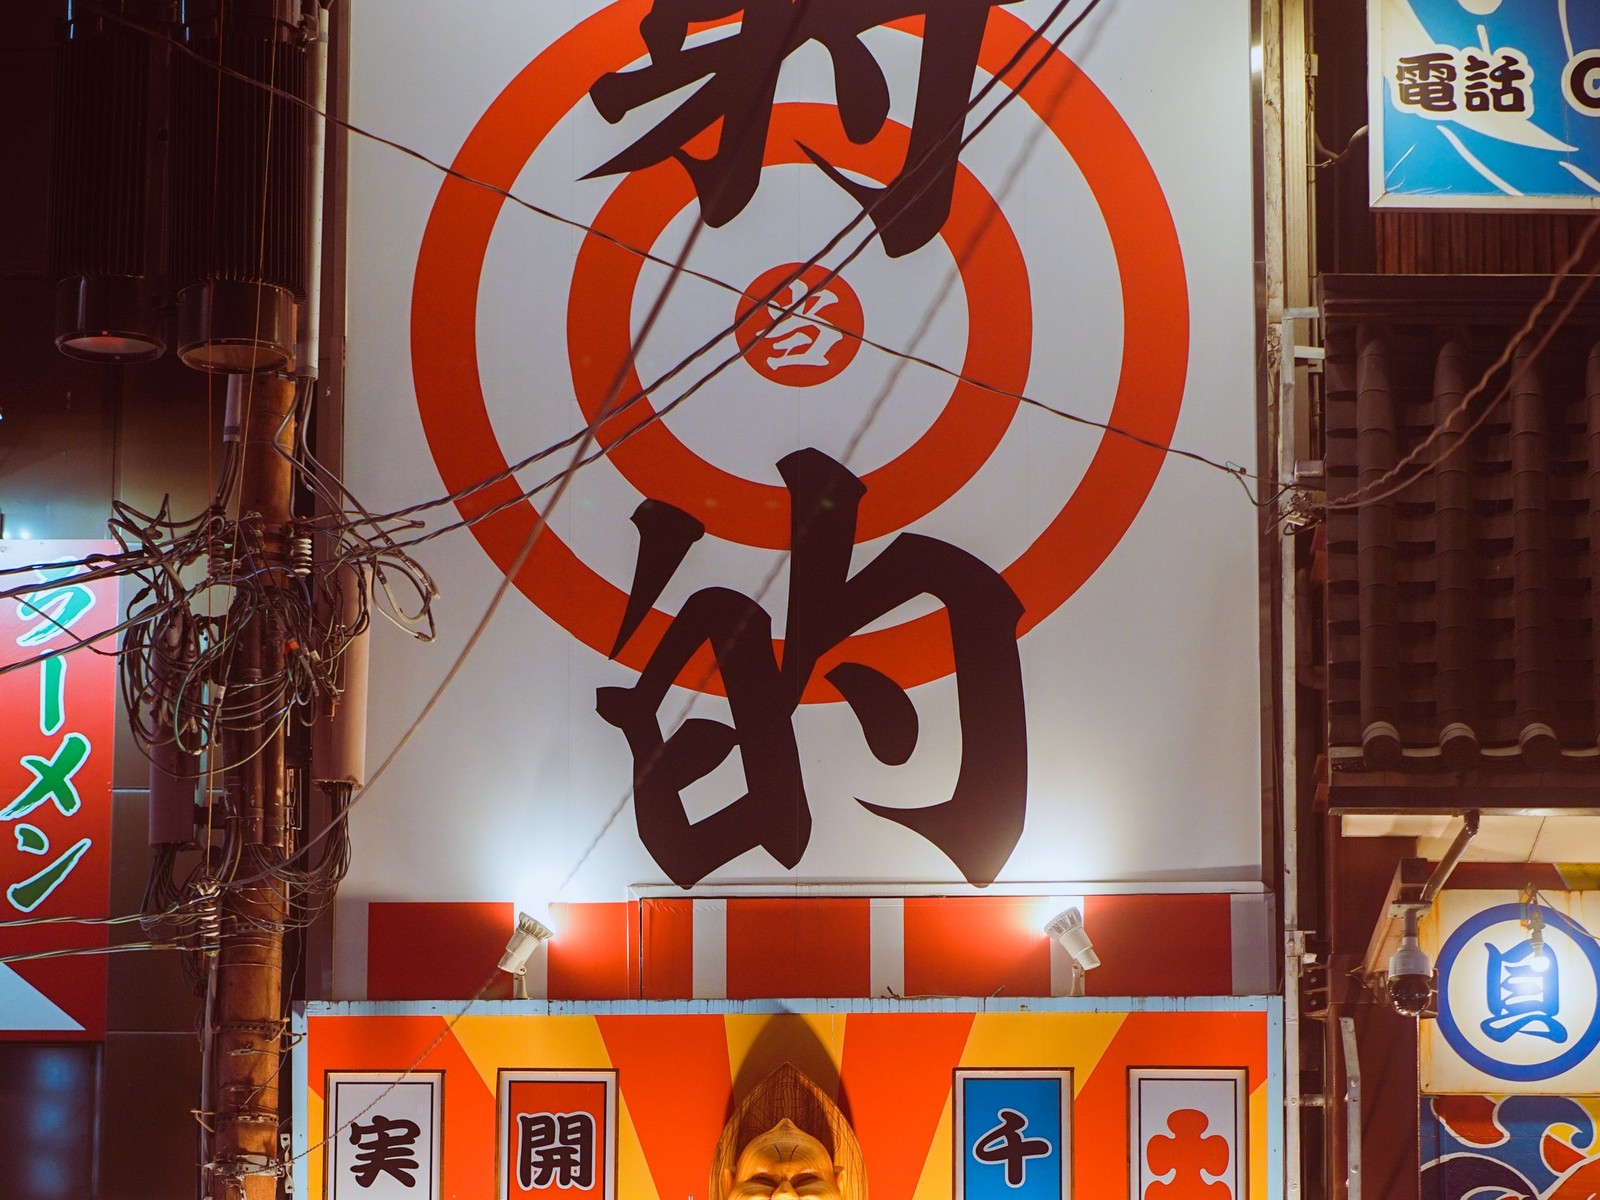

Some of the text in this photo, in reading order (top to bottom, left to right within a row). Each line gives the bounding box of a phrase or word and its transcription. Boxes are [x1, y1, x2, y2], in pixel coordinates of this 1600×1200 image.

[1396, 53, 1526, 112] 電話
[0, 556, 96, 912] ラーメン
